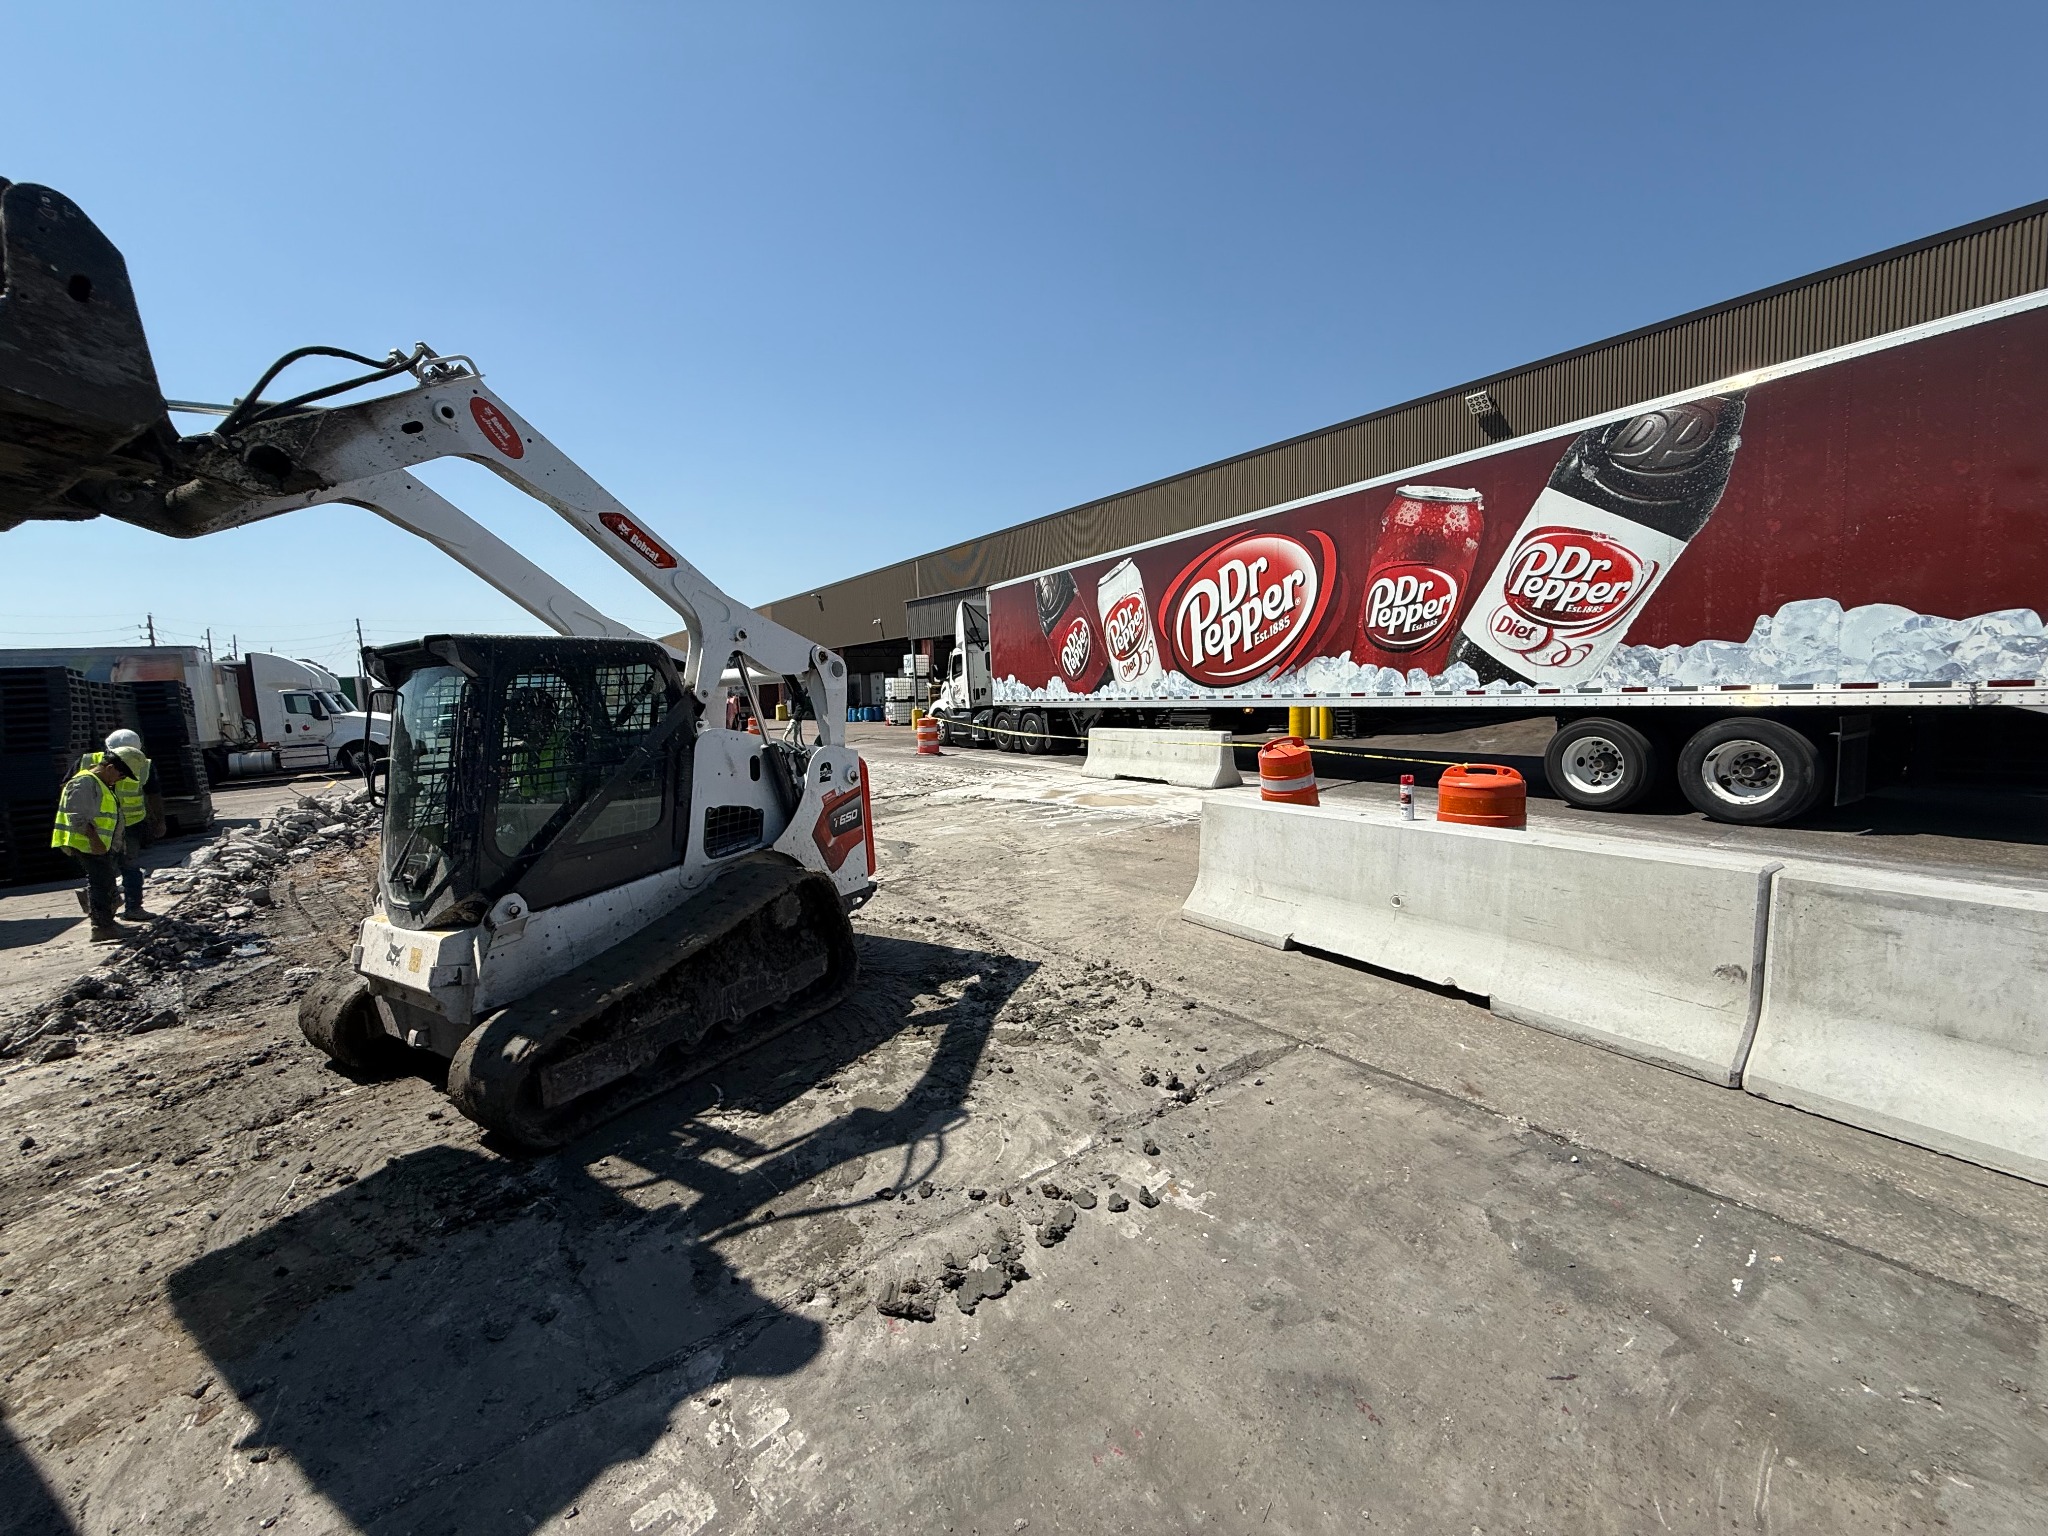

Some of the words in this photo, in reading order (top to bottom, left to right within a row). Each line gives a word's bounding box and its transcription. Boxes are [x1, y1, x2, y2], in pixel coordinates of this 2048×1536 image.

[630, 533, 659, 561] Bobcat
[1549, 545, 1612, 581] Dr
[1218, 556, 1268, 617] Dr
[1393, 575, 1434, 606] Dr
[1509, 542, 1632, 612] Pepper
[1117, 602, 1133, 632] Dr
[1176, 569, 1305, 668] Pepper
[1366, 577, 1452, 635] Pepper
[1066, 626, 1079, 655] Dr
[1109, 603, 1144, 657] Pepper
[1254, 614, 1291, 646] Est.1885
[1495, 615, 1538, 641] Diet
[833, 809, 858, 828] T650
